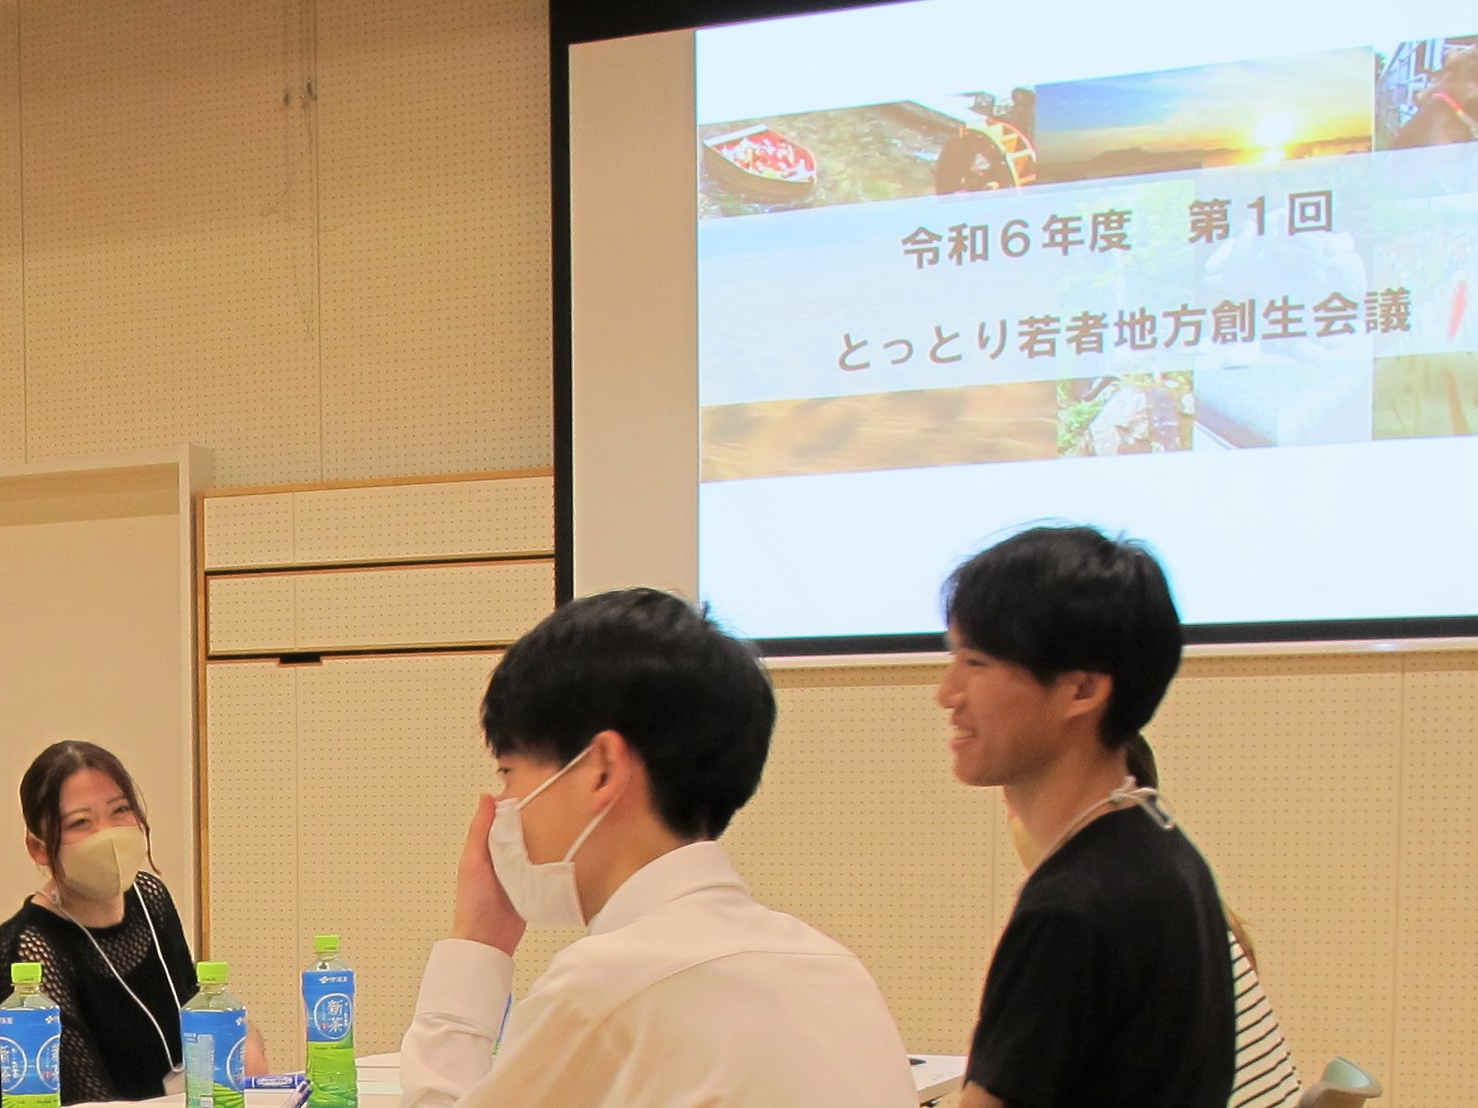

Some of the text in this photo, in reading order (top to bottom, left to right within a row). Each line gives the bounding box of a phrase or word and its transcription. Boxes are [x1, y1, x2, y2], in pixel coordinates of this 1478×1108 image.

[900, 189, 1334, 269] 令和６年度 第１回
[836, 288, 1413, 372] とっとり若者地方創生会議
[326, 999, 344, 1033] 新茶
